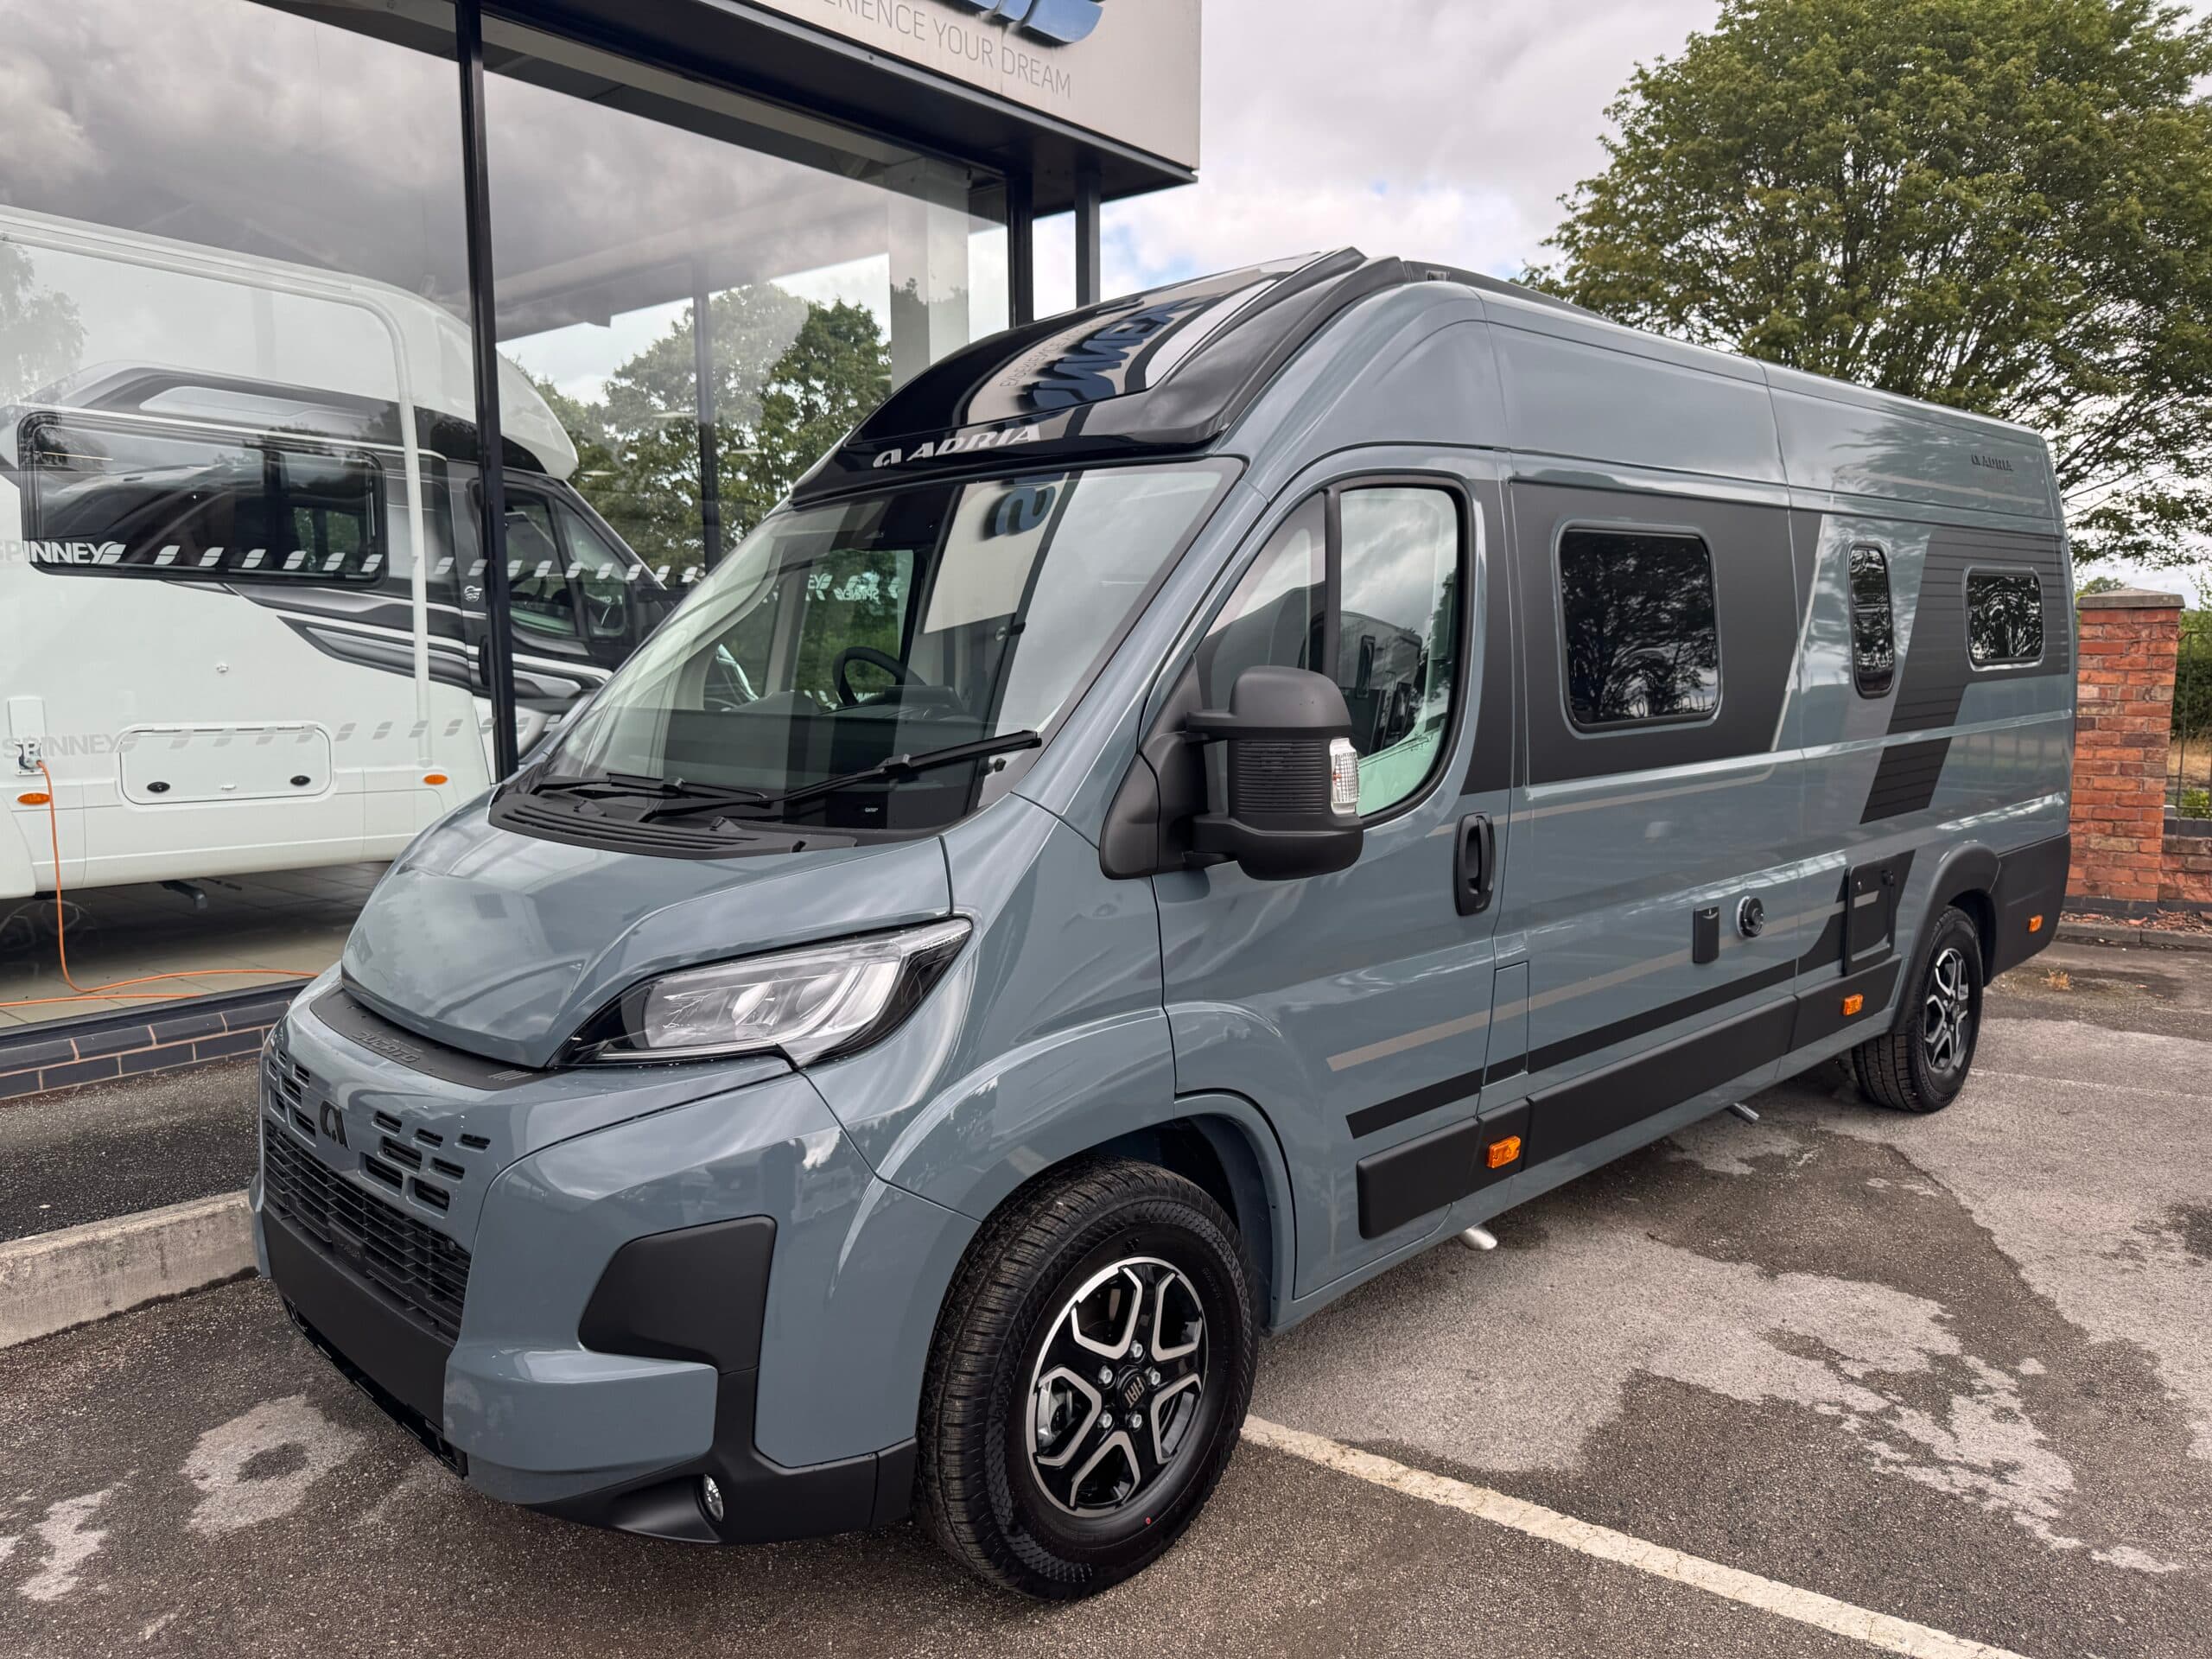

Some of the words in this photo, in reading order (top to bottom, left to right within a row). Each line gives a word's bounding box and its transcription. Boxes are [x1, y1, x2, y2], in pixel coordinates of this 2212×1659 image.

[932, 17, 995, 69] YOUR
[1001, 47, 1071, 99] DREAM
[906, 423, 1042, 461] ADRIA
[0, 539, 118, 563] PINNEY
[1123, 1376, 1146, 1409] FIAT
